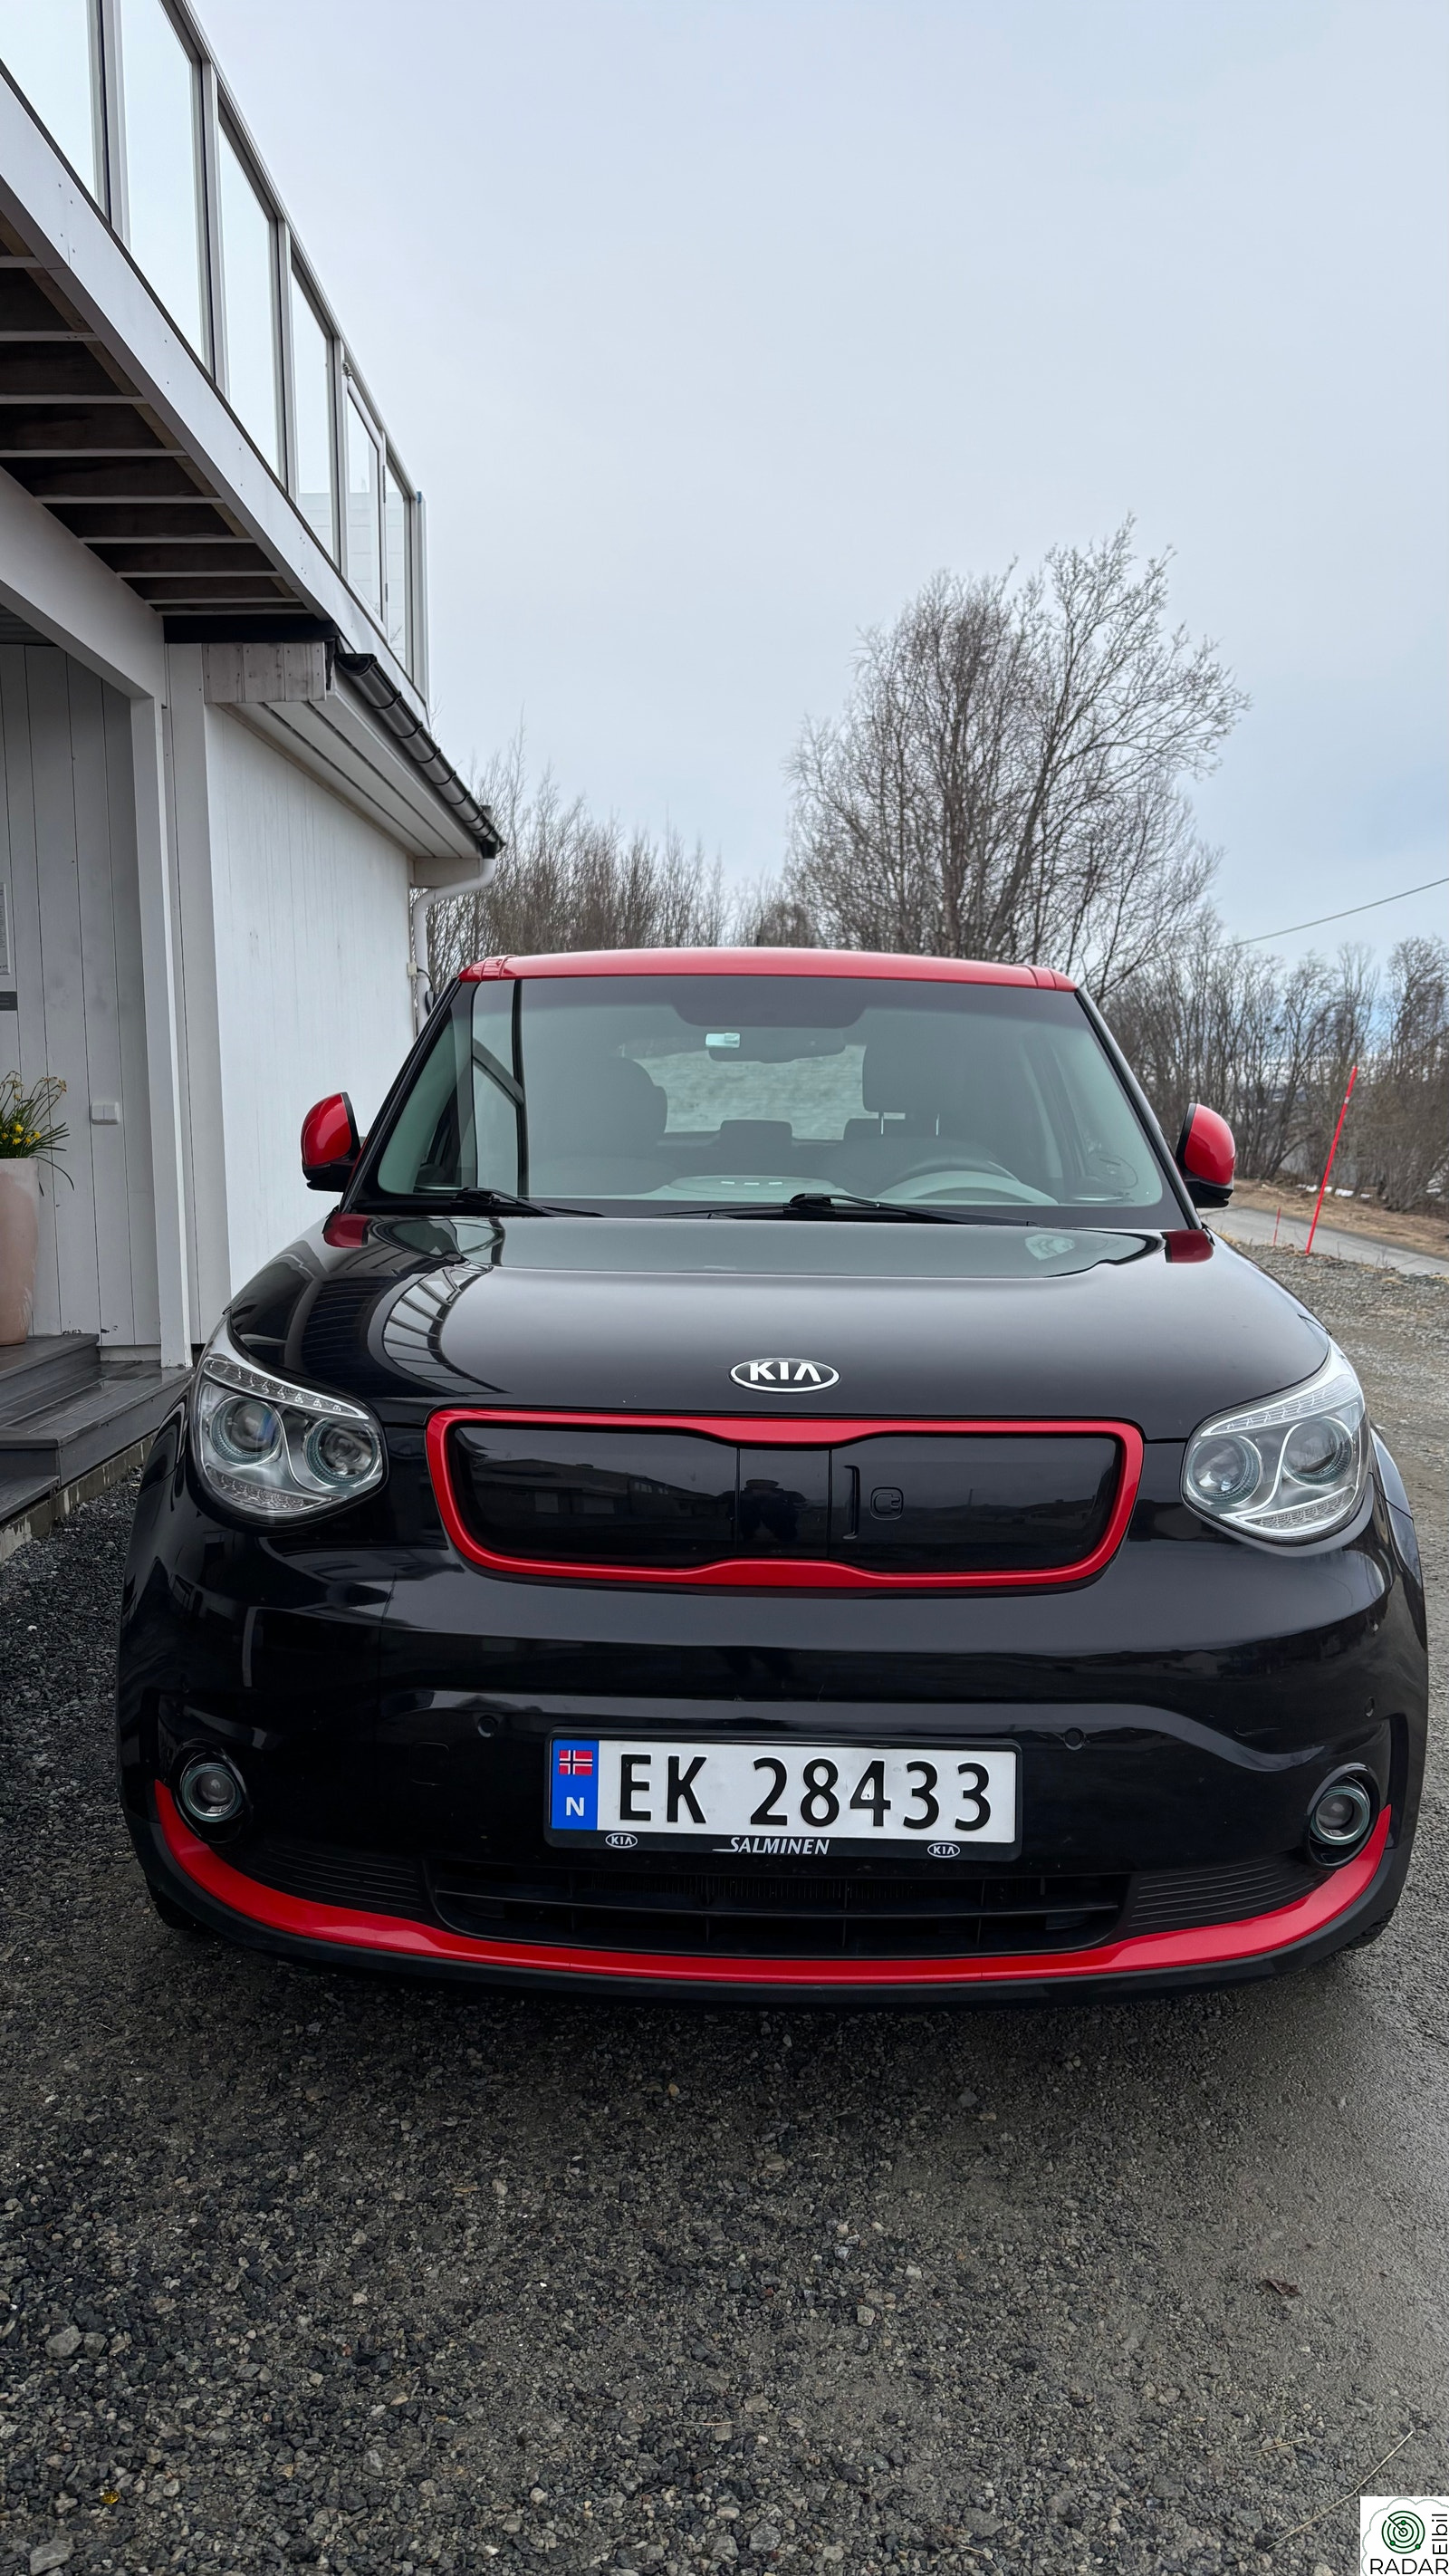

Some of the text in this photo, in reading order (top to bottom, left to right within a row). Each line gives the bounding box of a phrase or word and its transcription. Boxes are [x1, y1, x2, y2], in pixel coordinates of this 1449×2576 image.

[749, 1361, 822, 1383] KIA
[618, 1754, 992, 1831] EK 28433
[565, 1796, 585, 1817] N
[610, 1836, 633, 1846] KIA
[712, 1836, 830, 1855] SALMINEN
[933, 1845, 955, 1855] KIA
